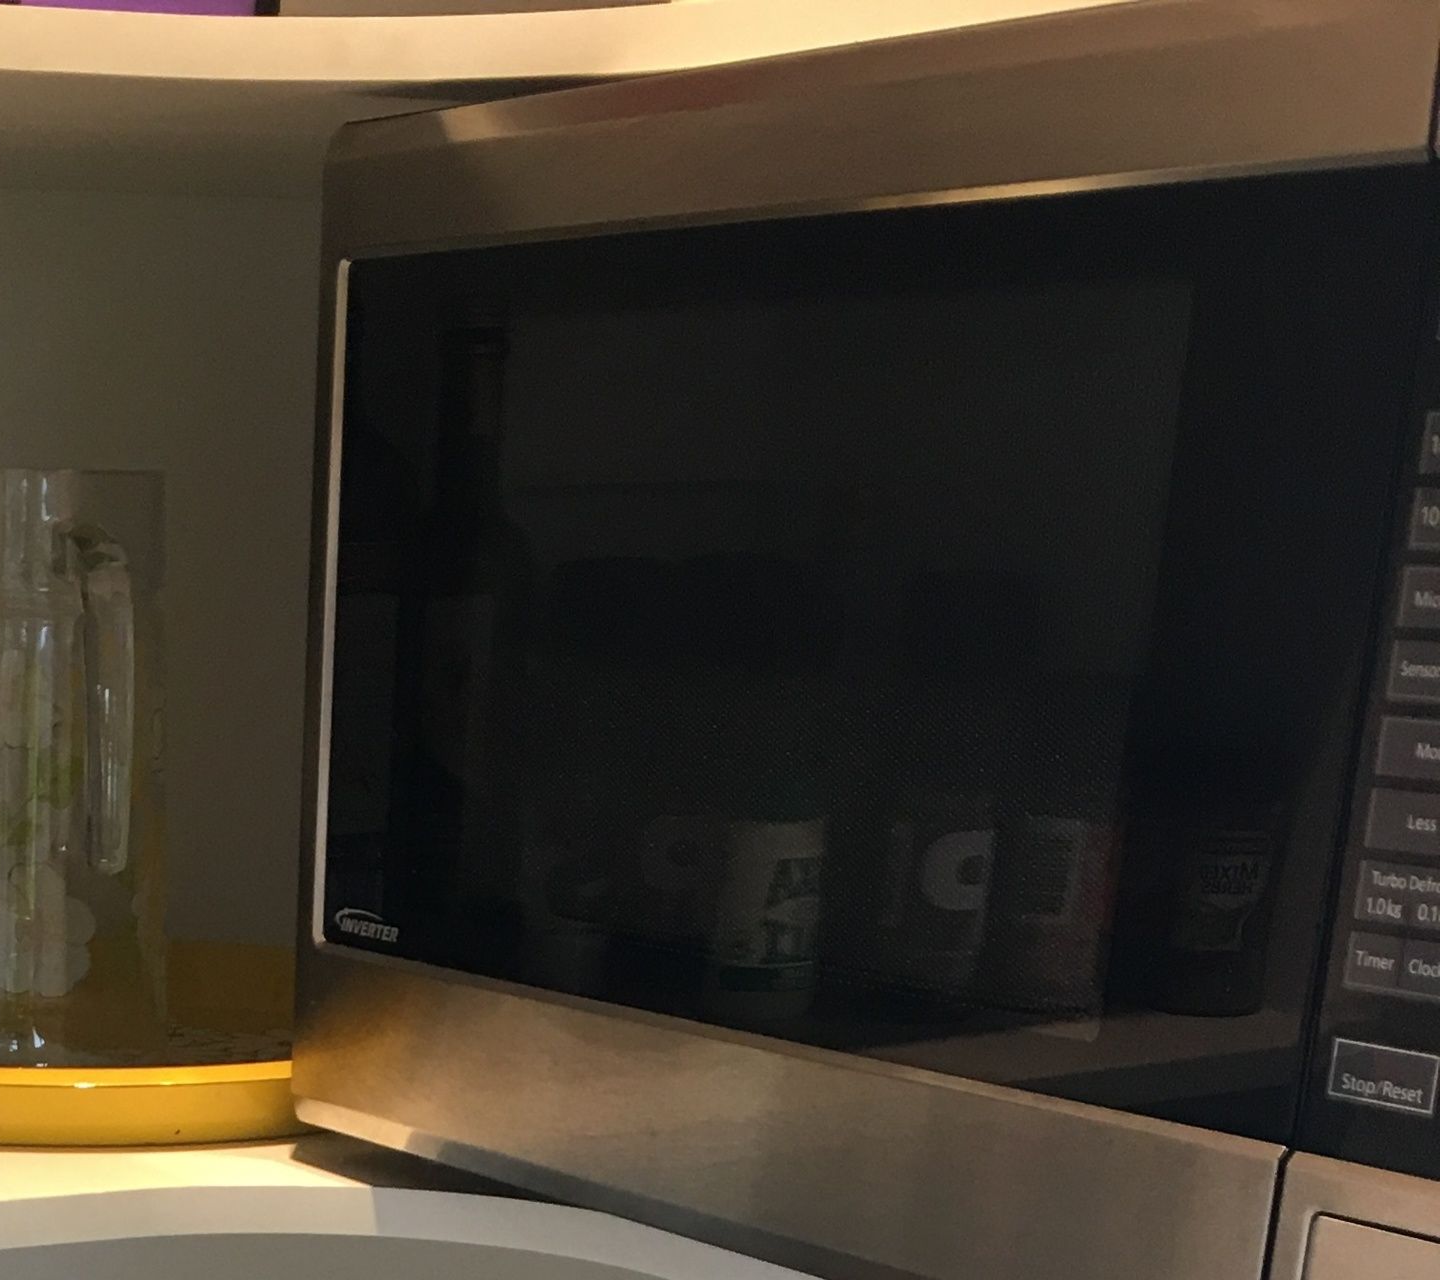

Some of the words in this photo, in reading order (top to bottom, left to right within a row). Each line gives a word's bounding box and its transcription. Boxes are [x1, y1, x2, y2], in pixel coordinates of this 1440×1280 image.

[1406, 813, 1437, 832] Less
[1371, 870, 1407, 889] Turbo
[339, 917, 400, 942] INVERTER
[1356, 949, 1395, 971] Timer
[1340, 1072, 1424, 1103] Stop/Reset
